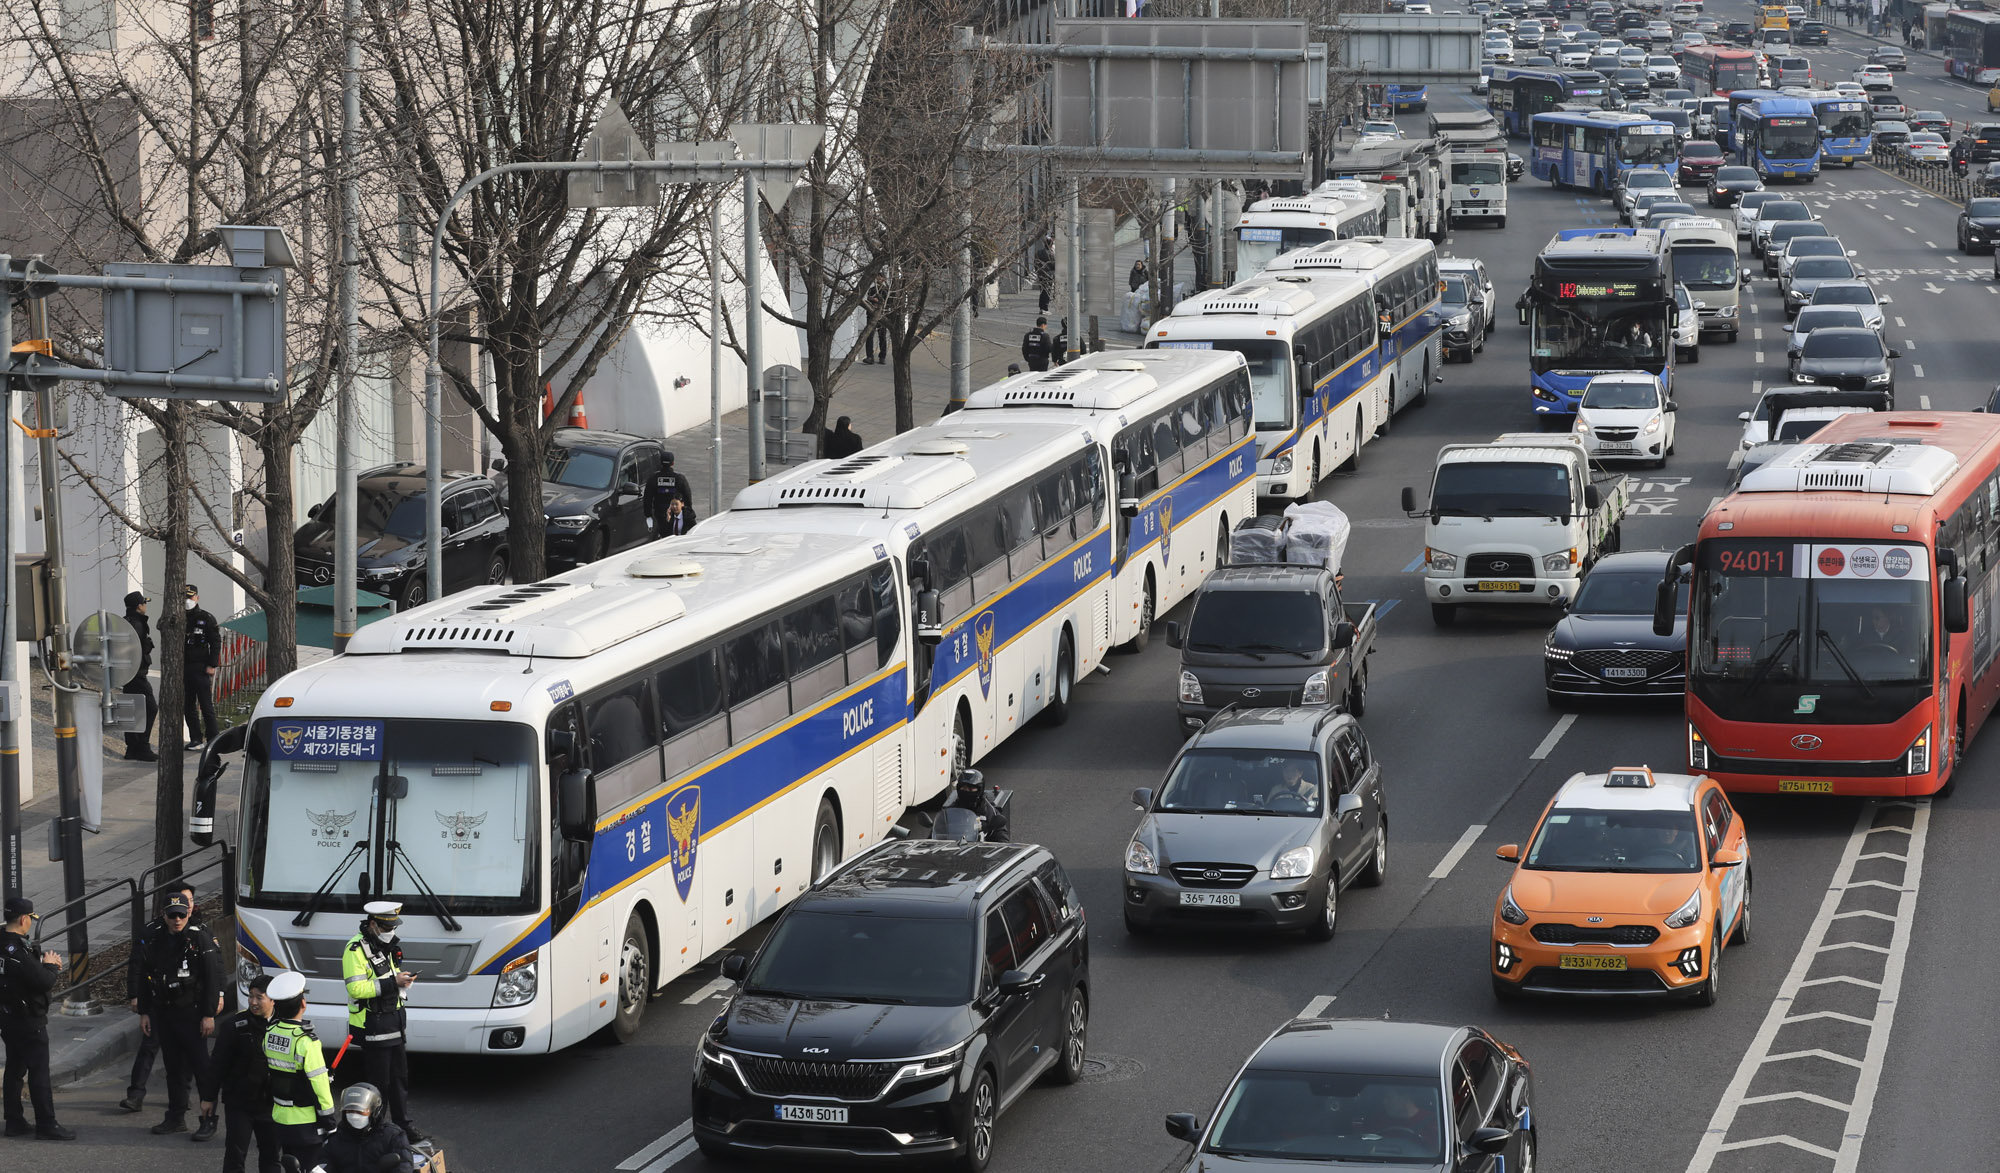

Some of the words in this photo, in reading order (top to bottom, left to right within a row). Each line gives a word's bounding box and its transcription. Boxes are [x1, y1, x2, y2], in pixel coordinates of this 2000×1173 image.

[1560, 283, 1576, 298] 142
[1229, 455, 1243, 479] POLICE
[1073, 551, 1092, 582] POLICE
[1720, 550, 1784, 572] 9401-1
[1627, 668, 1645, 677] 3300
[843, 698, 874, 740] POLICE
[304, 725, 376, 740] 서울기동경찰
[303, 742, 375, 756] 제73기동대-1
[1807, 783, 1829, 791] 1712
[677, 866, 692, 884] POLICE
[1209, 894, 1236, 905] 7480
[1594, 957, 1622, 969] 7682
[268, 1043, 286, 1052] POLICE
[783, 1107, 814, 1122] 143하
[816, 1108, 845, 1124] 5011
